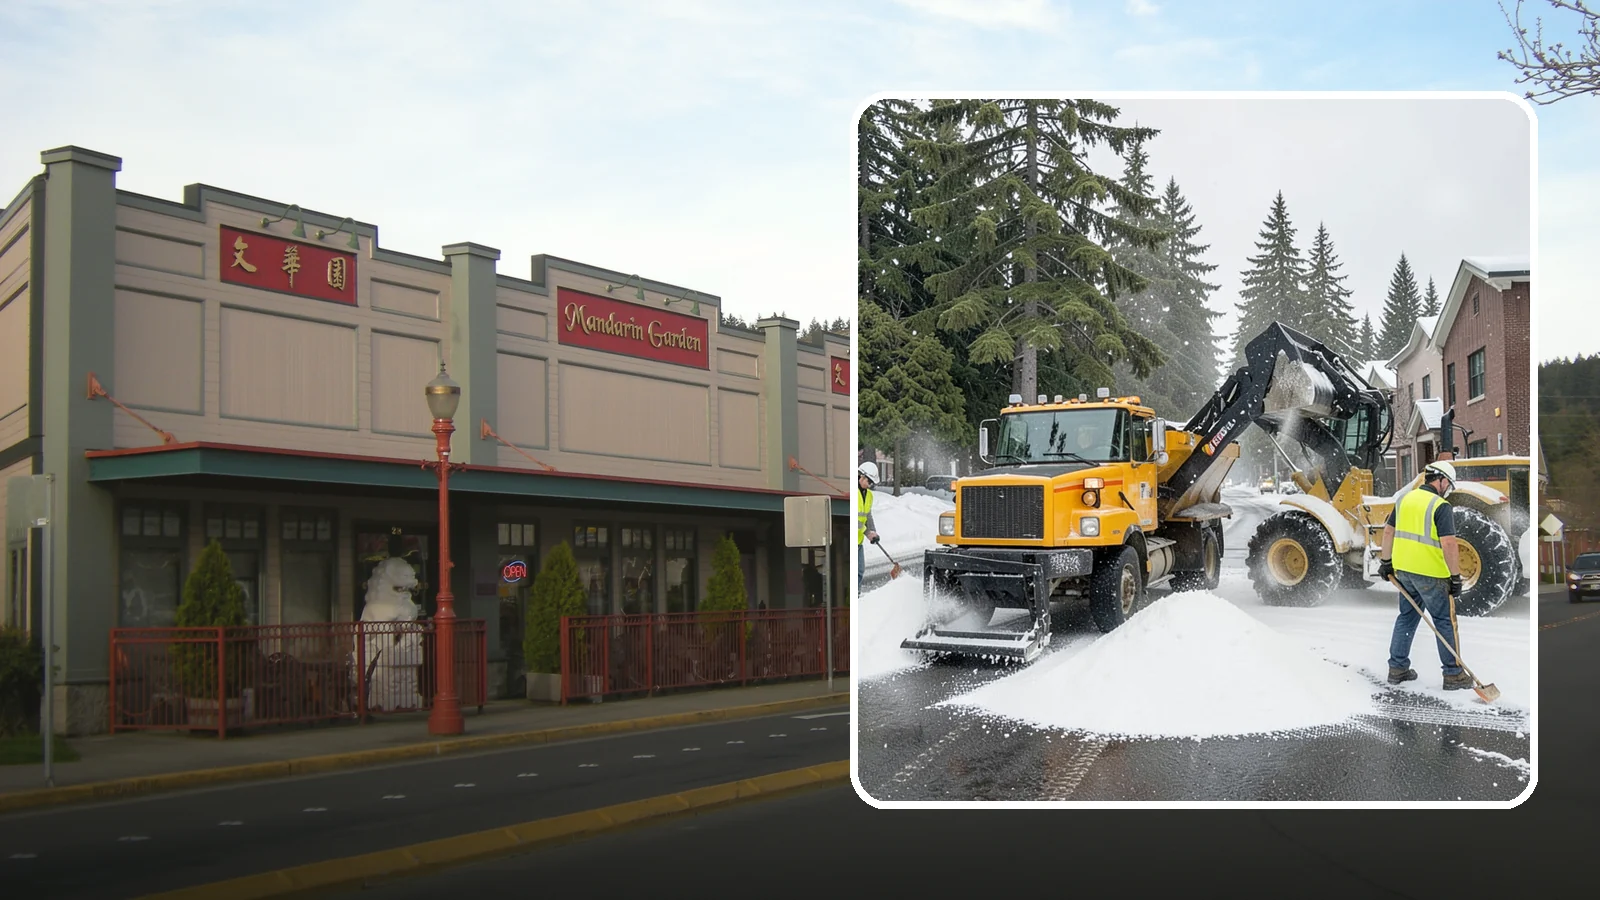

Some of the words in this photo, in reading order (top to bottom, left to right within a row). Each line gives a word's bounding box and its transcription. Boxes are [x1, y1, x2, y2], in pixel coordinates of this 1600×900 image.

[231, 236, 346, 290] 文華園
[564, 302, 644, 341] Mandarin
[648, 320, 702, 352] Garden
[503, 565, 527, 578] OPEN
